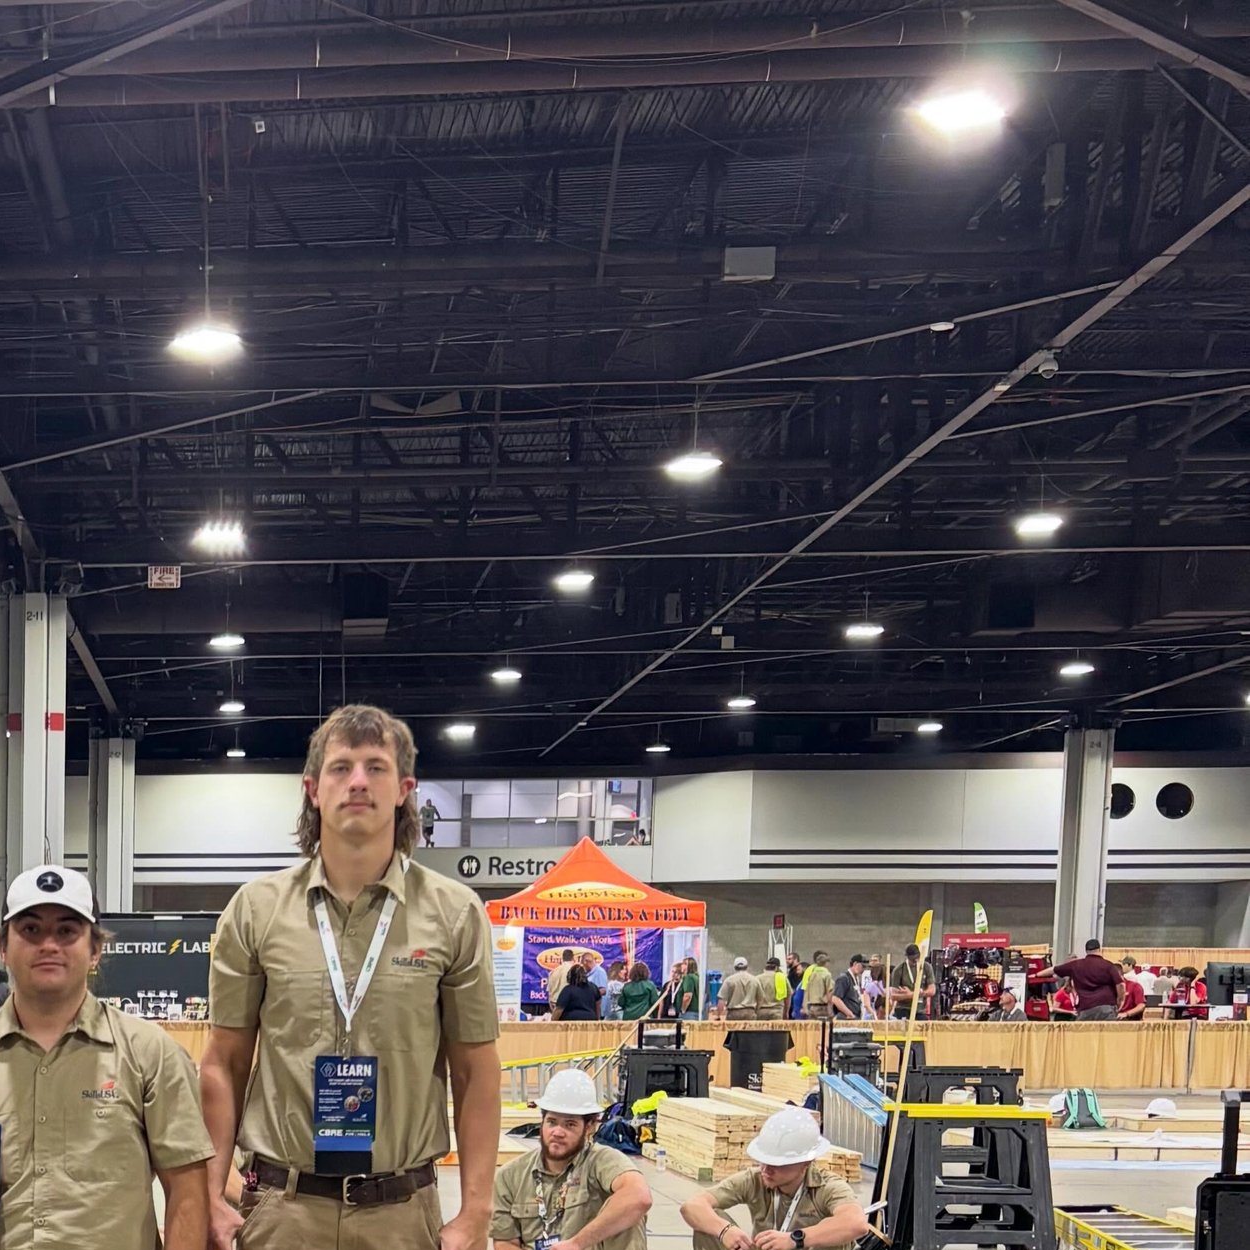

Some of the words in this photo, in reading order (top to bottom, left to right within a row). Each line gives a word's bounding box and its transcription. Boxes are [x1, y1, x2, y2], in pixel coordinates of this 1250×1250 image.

[26, 611, 44, 621] 2-11
[500, 905, 540, 920] BACK
[545, 906, 581, 921] HIPS
[586, 905, 634, 921] KNEES
[638, 909, 649, 921] &
[654, 907, 691, 921] FEET
[337, 1063, 372, 1077] LEARN
